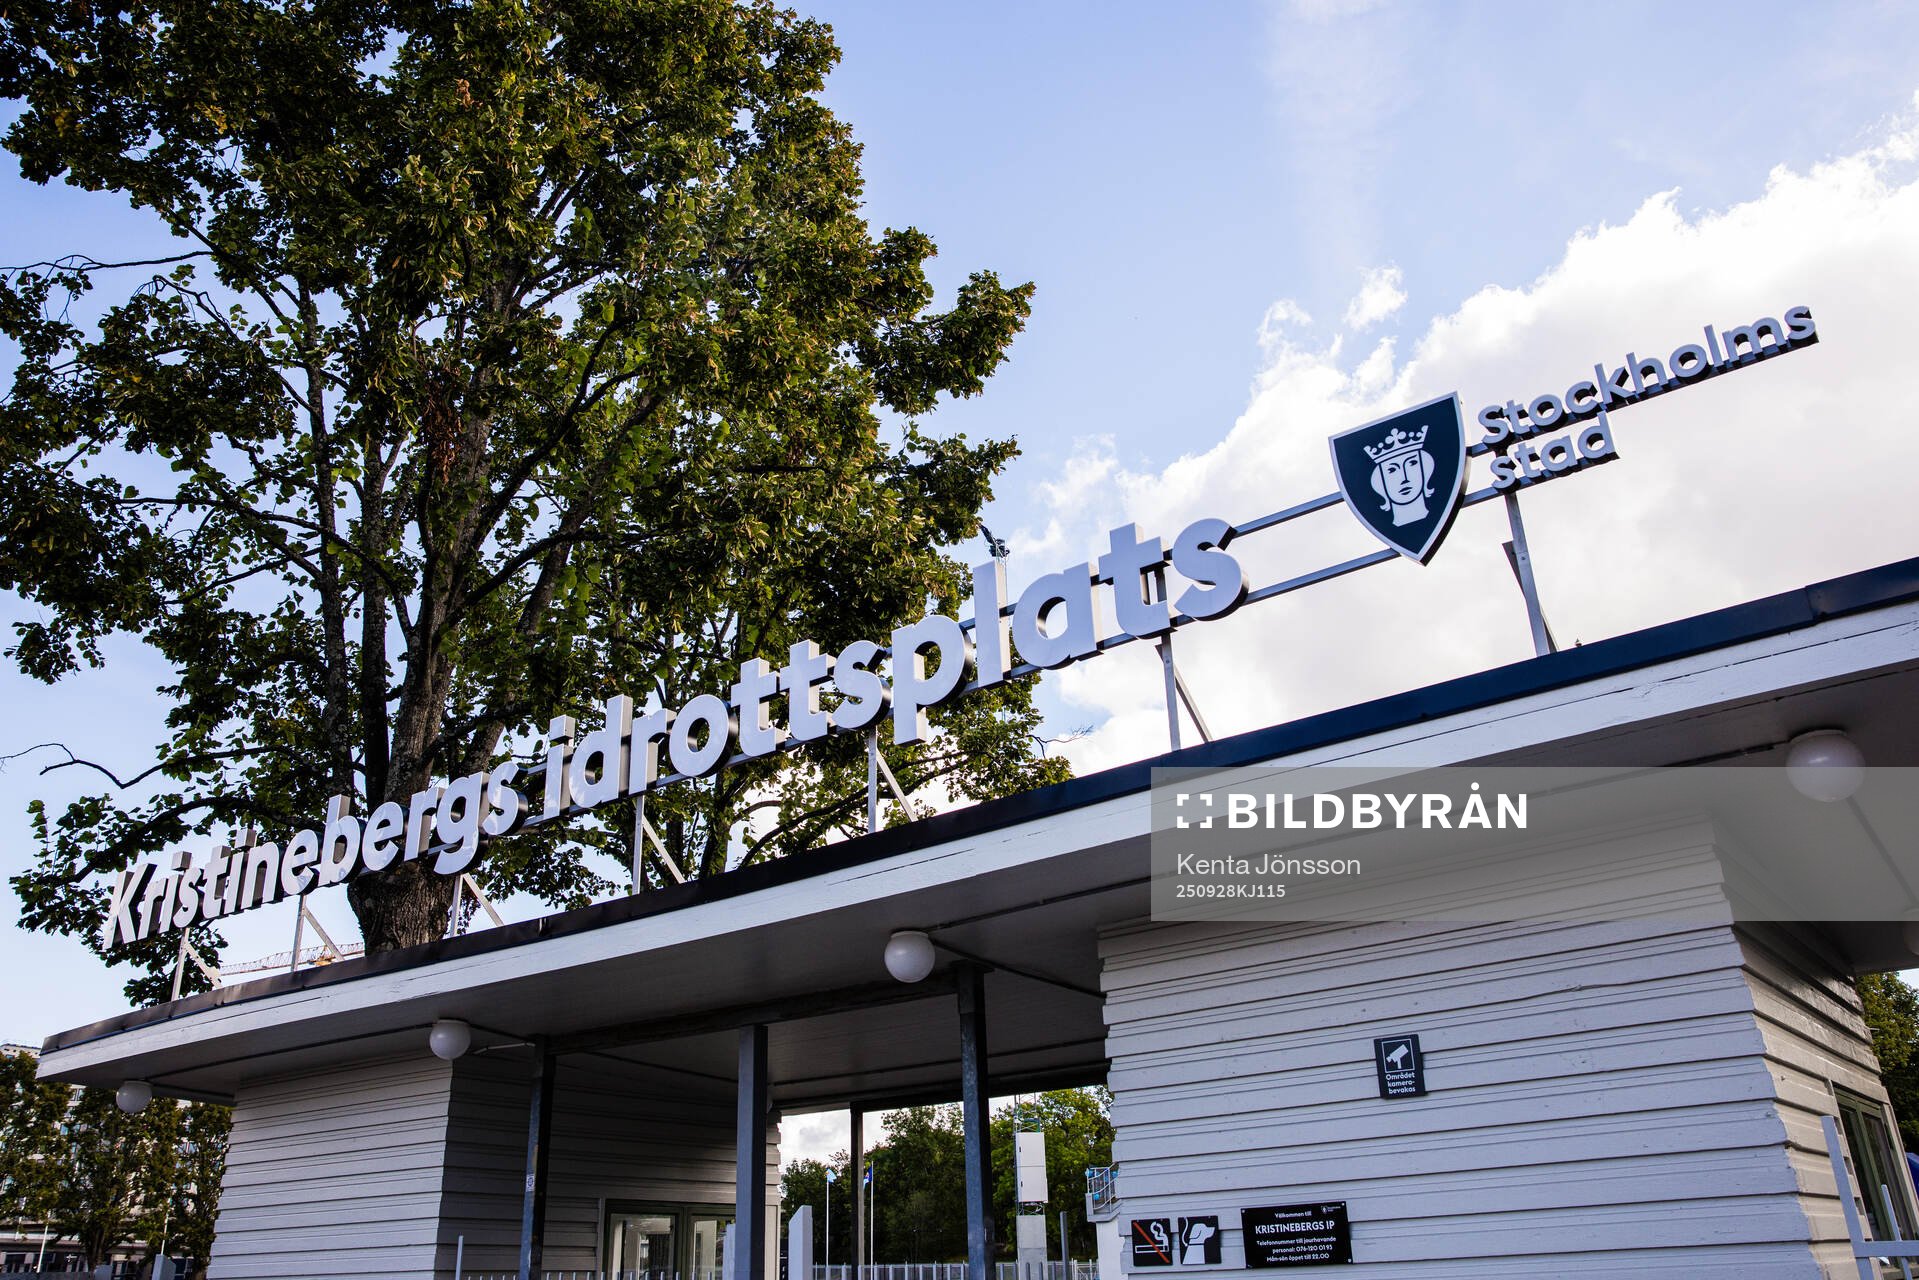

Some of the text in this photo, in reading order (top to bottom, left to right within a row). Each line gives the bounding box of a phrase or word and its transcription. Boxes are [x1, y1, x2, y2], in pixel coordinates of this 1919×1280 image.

[1477, 305, 1819, 446] Stockholms
[1490, 411, 1621, 492] stad
[102, 517, 1249, 951] Kristinebergs idrottsplats
[1255, 1220, 1335, 1235] KRISTINEBERGS IP
